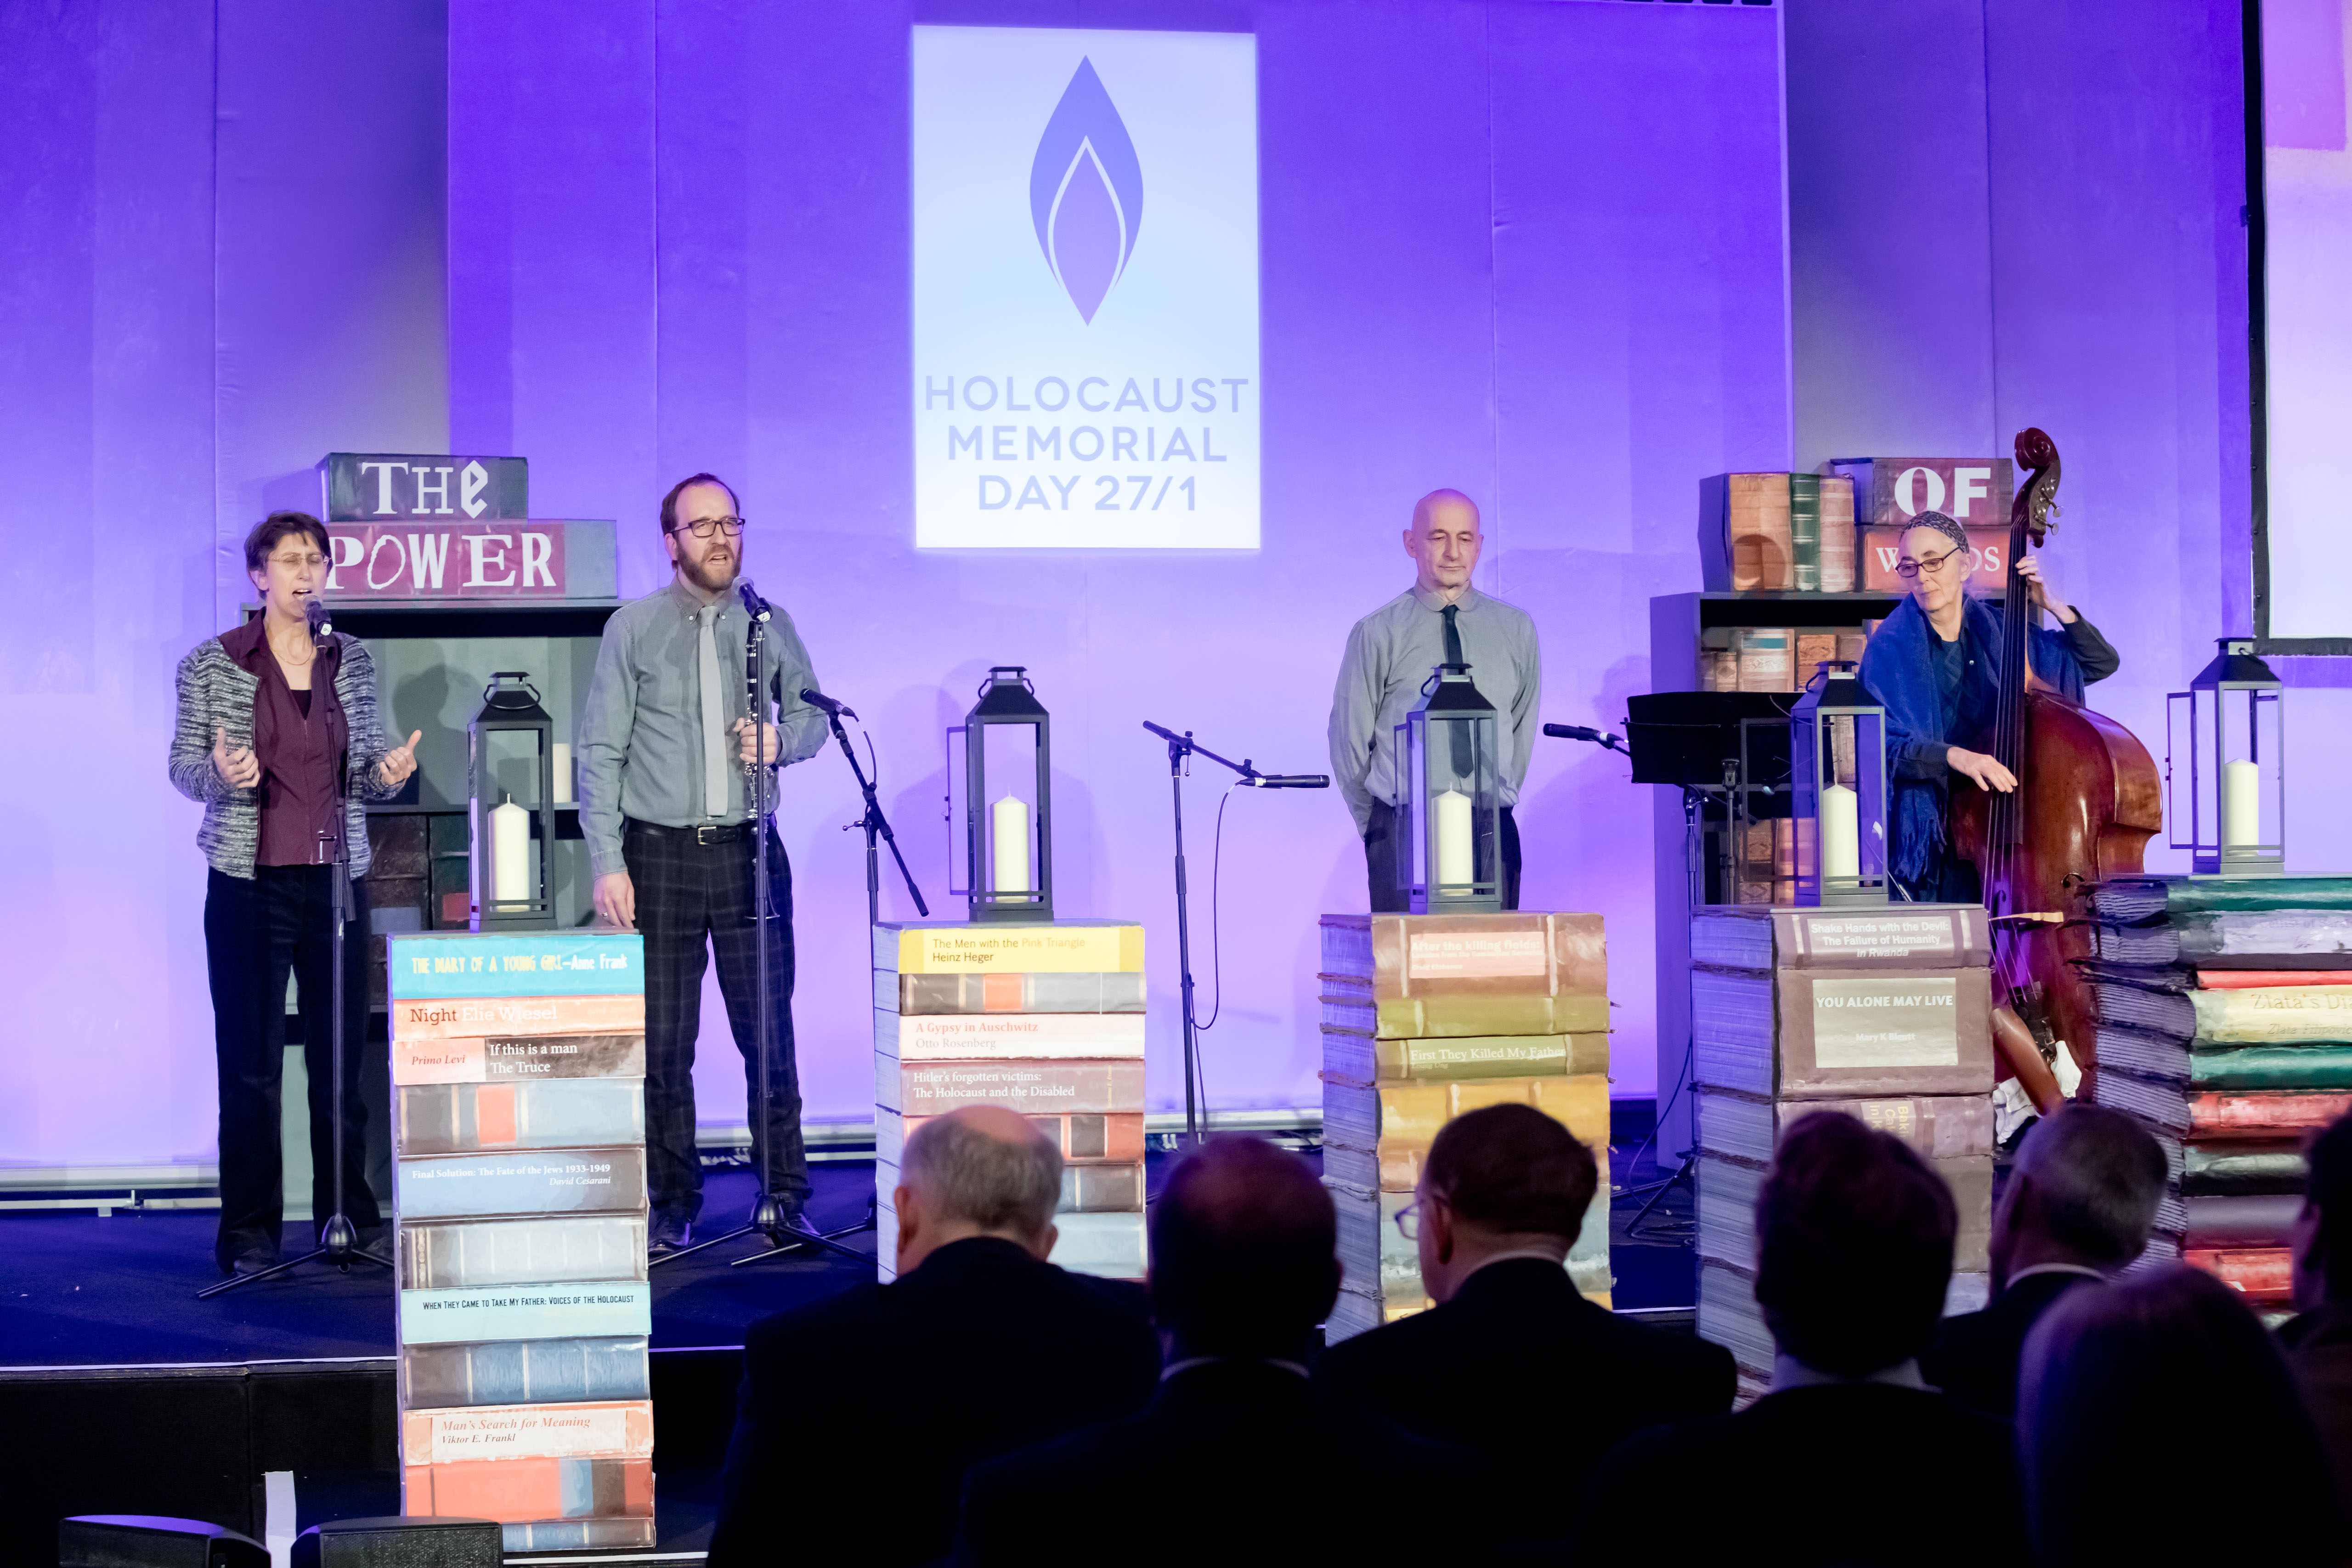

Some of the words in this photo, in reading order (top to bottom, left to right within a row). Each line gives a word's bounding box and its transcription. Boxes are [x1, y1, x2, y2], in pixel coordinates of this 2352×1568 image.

[926, 375, 1249, 413] HOLOCAUST
[948, 425, 1227, 462] MEMORIAL
[978, 475, 1081, 511] DAY
[1095, 475, 1195, 511] 27/1
[1894, 467, 1991, 517] OF
[325, 532, 556, 590] POWER
[1811, 924, 1842, 933] Shake
[1845, 924, 1877, 933] Hands
[1879, 923, 1900, 932] with
[1903, 923, 1918, 931] the
[933, 939, 951, 948] The
[955, 938, 976, 948] Men
[979, 938, 1000, 948] with
[1003, 938, 1018, 948] the
[1022, 937, 1043, 948] Pink
[1047, 937, 1085, 950] Triangle
[1411, 941, 1440, 951] After
[1444, 941, 1463, 951] the
[1465, 940, 1501, 952] killing
[1822, 936, 1841, 945] The
[1844, 936, 1877, 945] Failure
[1880, 935, 1890, 944] of
[1893, 935, 1940, 945] Humanity
[933, 952, 961, 962] Heinz
[964, 952, 994, 964] Heger
[1869, 948, 1909, 957] Rwanda
[412, 957, 430, 974] THE
[435, 957, 465, 973] DIARY
[471, 957, 483, 973] OF
[489, 956, 497, 972] A
[503, 955, 535, 972] YOUNG
[600, 953, 628, 969] Frank
[1816, 997, 1843, 1008] YOU
[1847, 996, 1890, 1008] ALONE
[1893, 996, 1922, 1007] MAY
[1925, 995, 1953, 1006] LIVE
[2250, 994, 2320, 1009] Zlata's
[410, 1008, 457, 1025] Night
[462, 1007, 494, 1022] Elie
[499, 1006, 558, 1020] Wiesel
[916, 1023, 923, 1032] A
[927, 1023, 961, 1035] Gypsy
[966, 1022, 975, 1032] in
[979, 1021, 1038, 1032] Auschwitz
[490, 1044, 501, 1055] If
[503, 1043, 525, 1055] this
[528, 1044, 537, 1054] is
[551, 1045, 577, 1053] man
[916, 1038, 939, 1048] Otto
[943, 1037, 996, 1051] Rosenberg
[412, 1056, 441, 1065] Primo
[445, 1054, 465, 1064] Levi
[1411, 1049, 1436, 1061] First
[1438, 1049, 1467, 1062] They
[1470, 1048, 1504, 1059] Killed
[1507, 1047, 1526, 1060] My
[490, 1062, 513, 1073] The
[516, 1062, 550, 1072] Truce
[952, 1071, 999, 1085] forgotten
[1001, 1072, 1041, 1082] victims:
[914, 1088, 933, 1098] The
[935, 1087, 986, 1098] Holocaust
[989, 1087, 1008, 1097] and
[1011, 1087, 1027, 1097] the
[1031, 1086, 1074, 1096] Disabled
[413, 1170, 434, 1179] Final
[436, 1168, 476, 1178] Solution:
[478, 1167, 494, 1176] The
[497, 1166, 514, 1176] Fate
[517, 1166, 526, 1175] of
[527, 1165, 541, 1174] the
[543, 1165, 563, 1175] Jews
[565, 1164, 610, 1173] 1933-1949
[549, 1177, 573, 1186] David
[576, 1176, 611, 1185] Cesarani
[423, 1301, 442, 1310] WHEN
[444, 1301, 459, 1309] THEY
[462, 1300, 480, 1308] CAME
[492, 1299, 507, 1307] TAKE
[509, 1298, 519, 1306] MY
[521, 1297, 547, 1306] FATHER:
[549, 1296, 571, 1305] VOICES
[573, 1296, 581, 1304] OF
[583, 1296, 595, 1304] THE
[598, 1295, 634, 1303] HOLOCAUST
[479, 1419, 517, 1430] Search
[520, 1418, 537, 1431] for
[540, 1416, 590, 1428] Meaning
[442, 1435, 469, 1444] Viktor
[485, 1433, 515, 1442] Frankl
